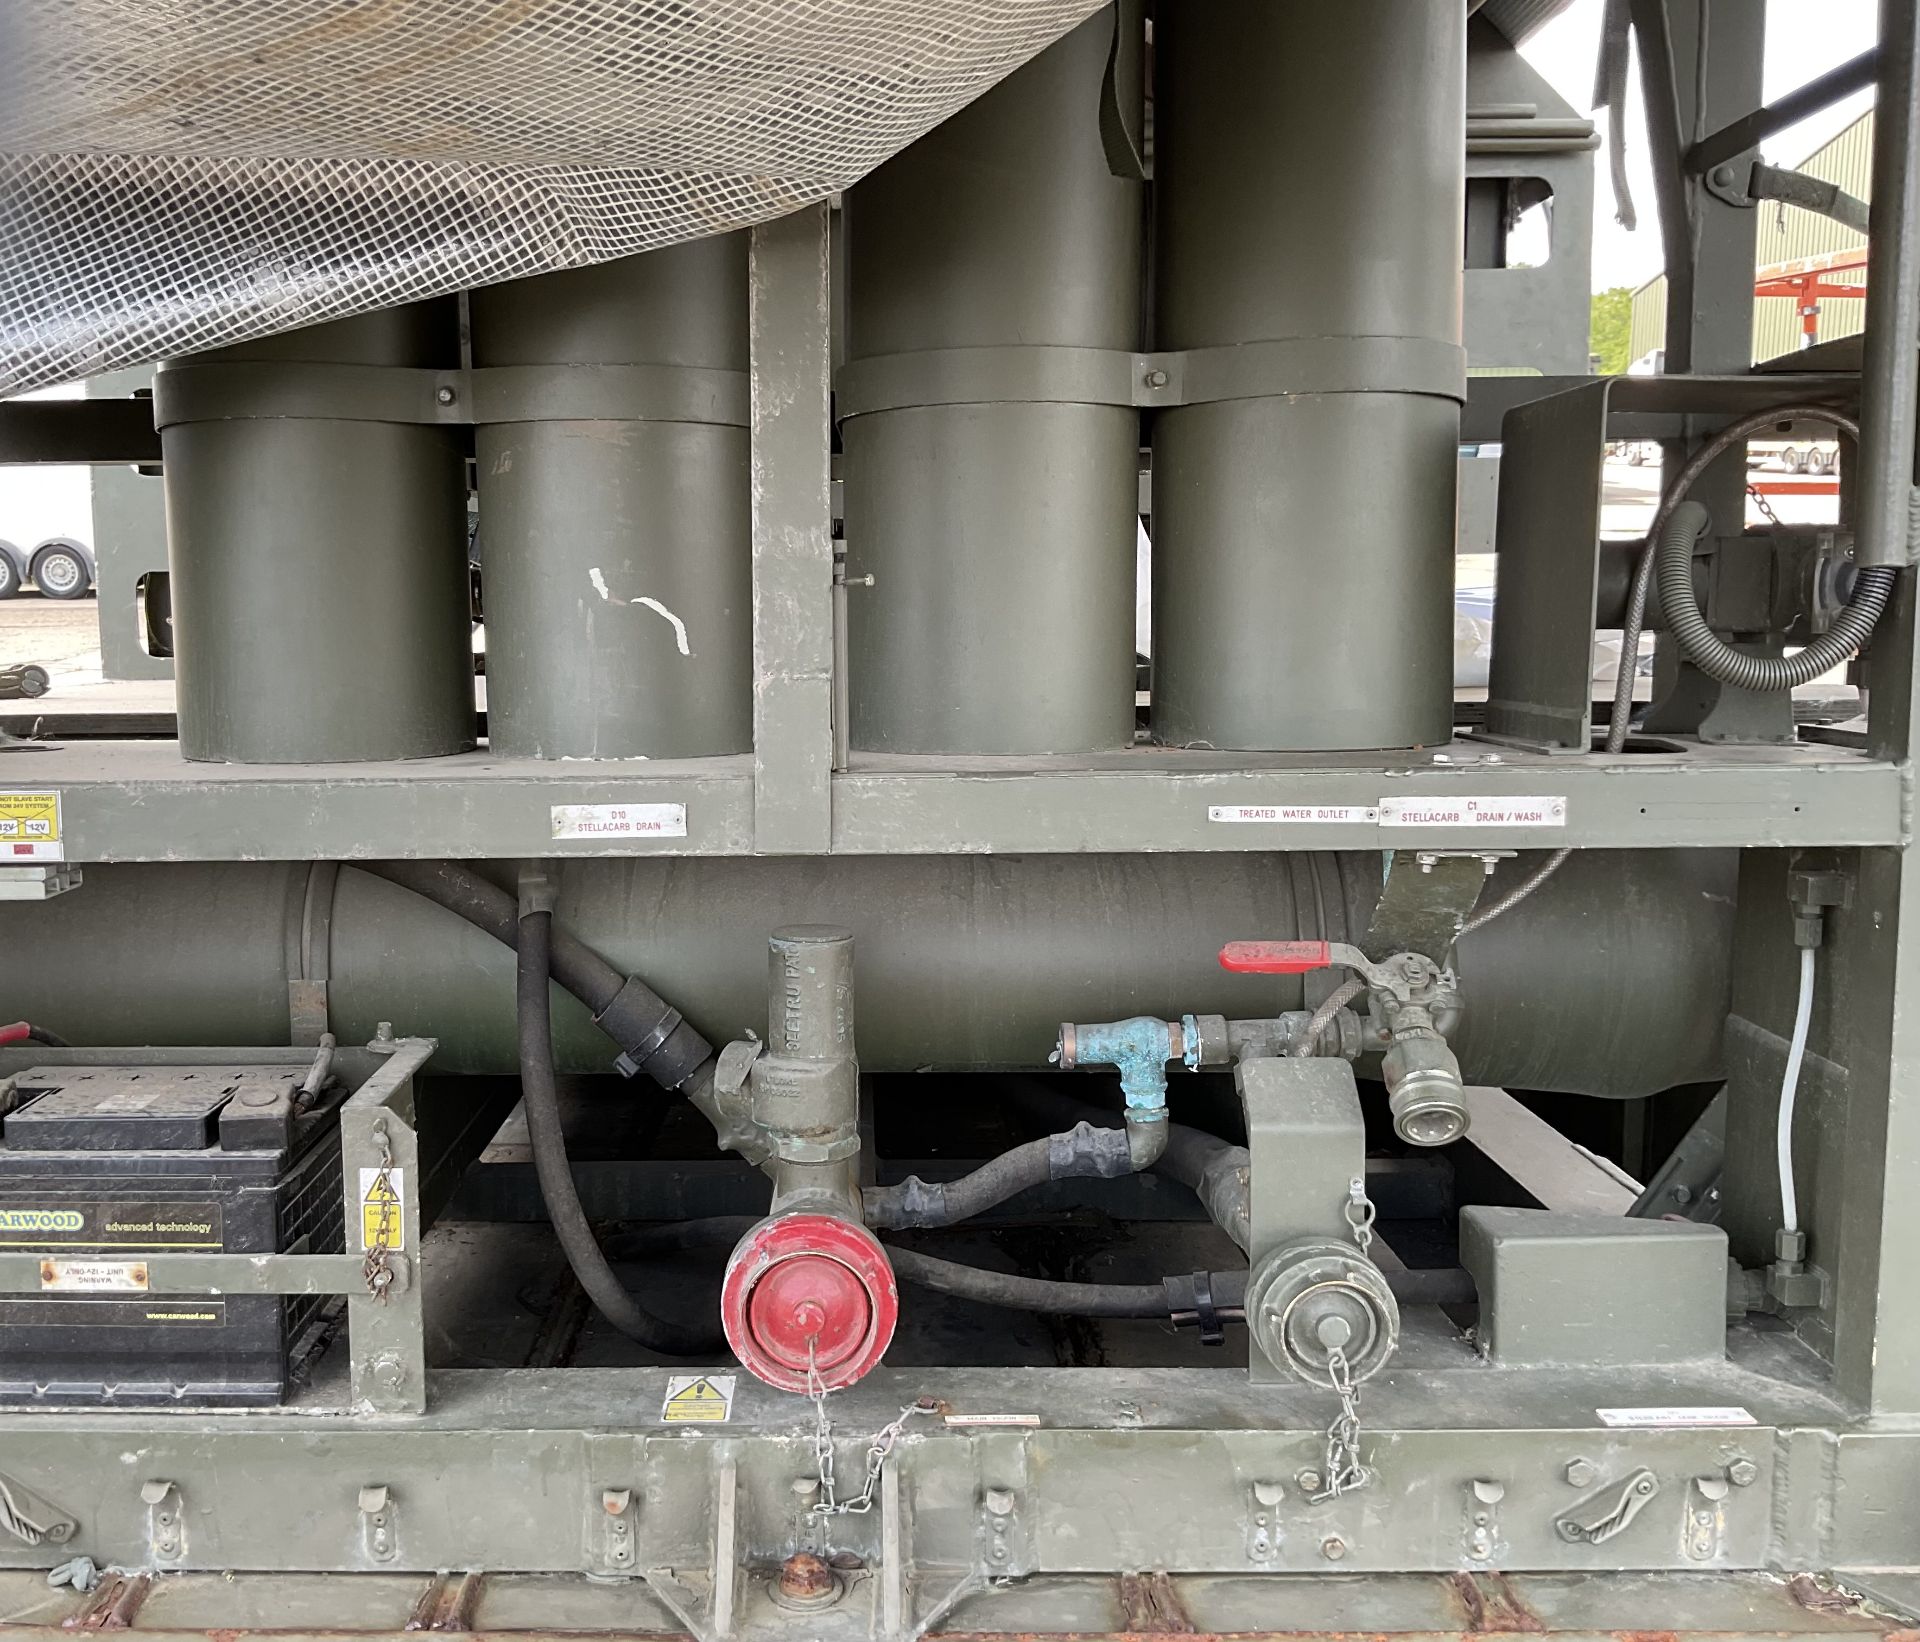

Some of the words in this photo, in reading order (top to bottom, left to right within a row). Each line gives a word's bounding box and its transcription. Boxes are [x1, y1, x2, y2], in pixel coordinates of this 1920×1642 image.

[1467, 801, 1477, 811] C1
[611, 810, 626, 820] D10
[1239, 809, 1276, 819] TREATED
[1282, 809, 1312, 819] WATER
[1318, 809, 1349, 819] OUTLET
[1401, 812, 1460, 823] STELLACARB
[31, 823, 46, 831] 12V
[577, 822, 631, 832] STELLACARB
[636, 822, 661, 831] DRAIN
[105, 1221, 154, 1231] advanced
[155, 1221, 212, 1233] technology
